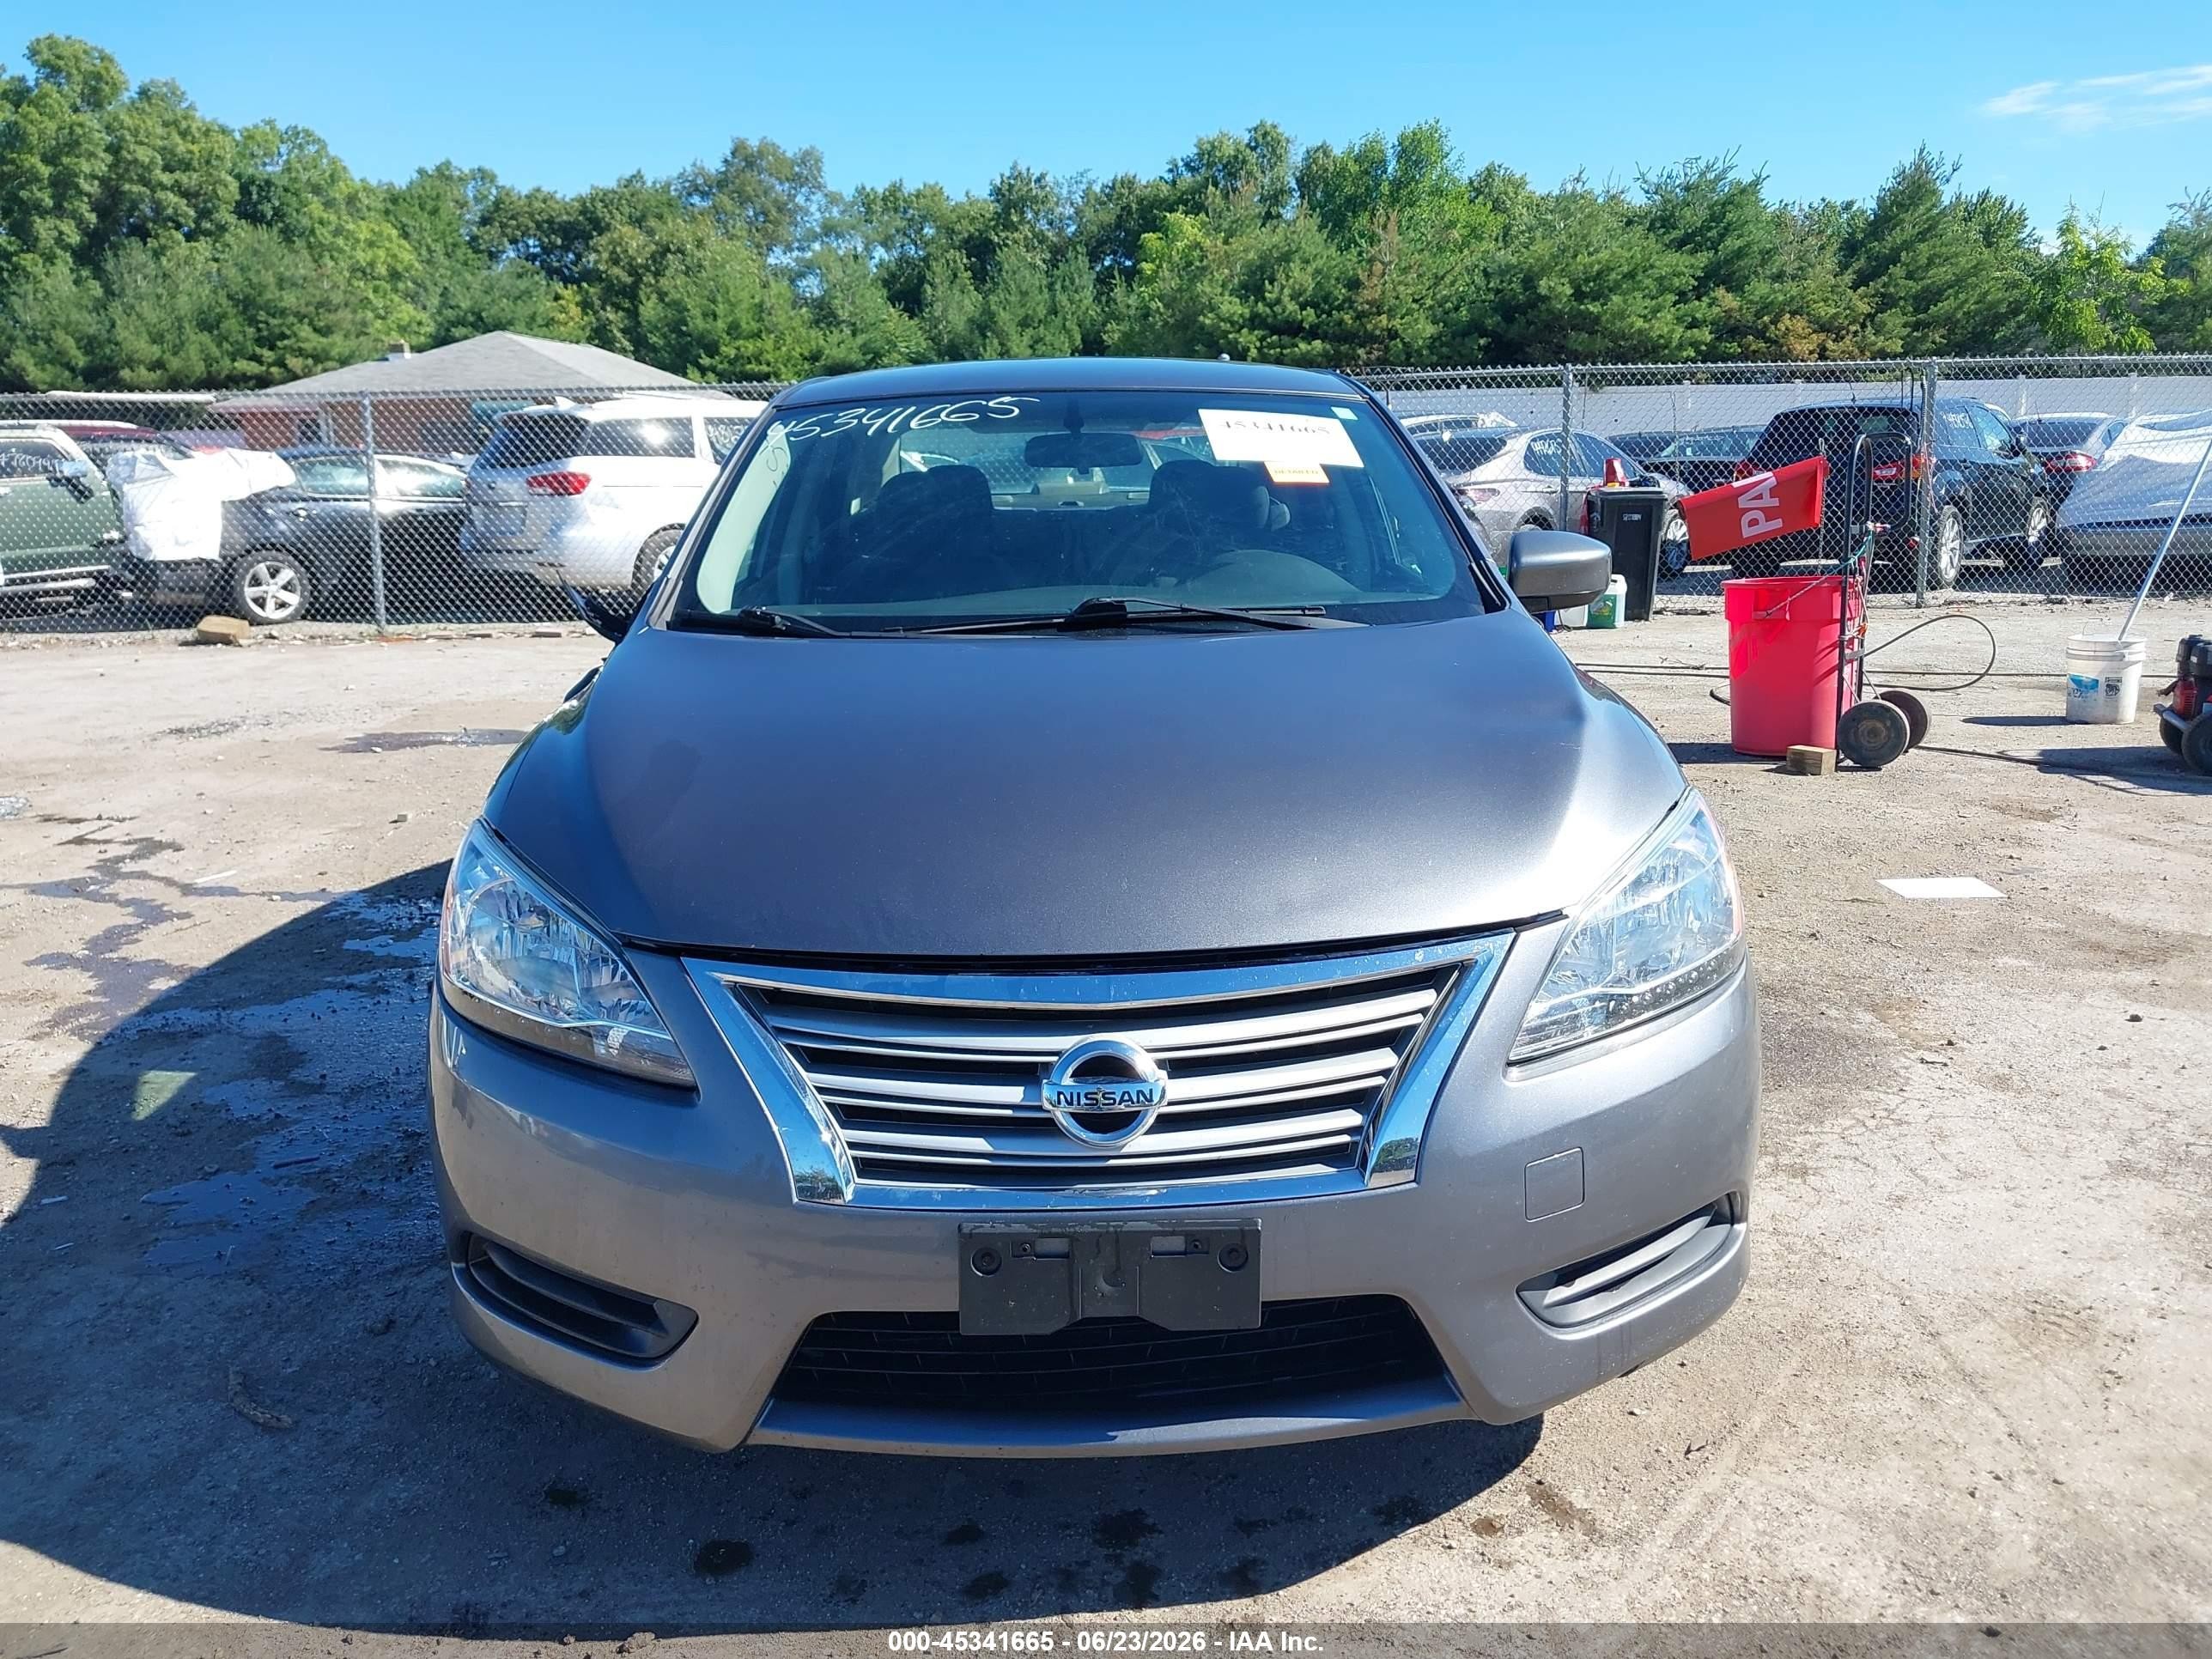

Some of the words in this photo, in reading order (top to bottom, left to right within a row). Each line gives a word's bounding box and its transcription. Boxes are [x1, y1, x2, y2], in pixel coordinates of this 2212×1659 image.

[767, 396, 1041, 447] 45341665
[1731, 471, 1784, 539] PA
[1056, 1087, 1154, 1107] NISSAN
